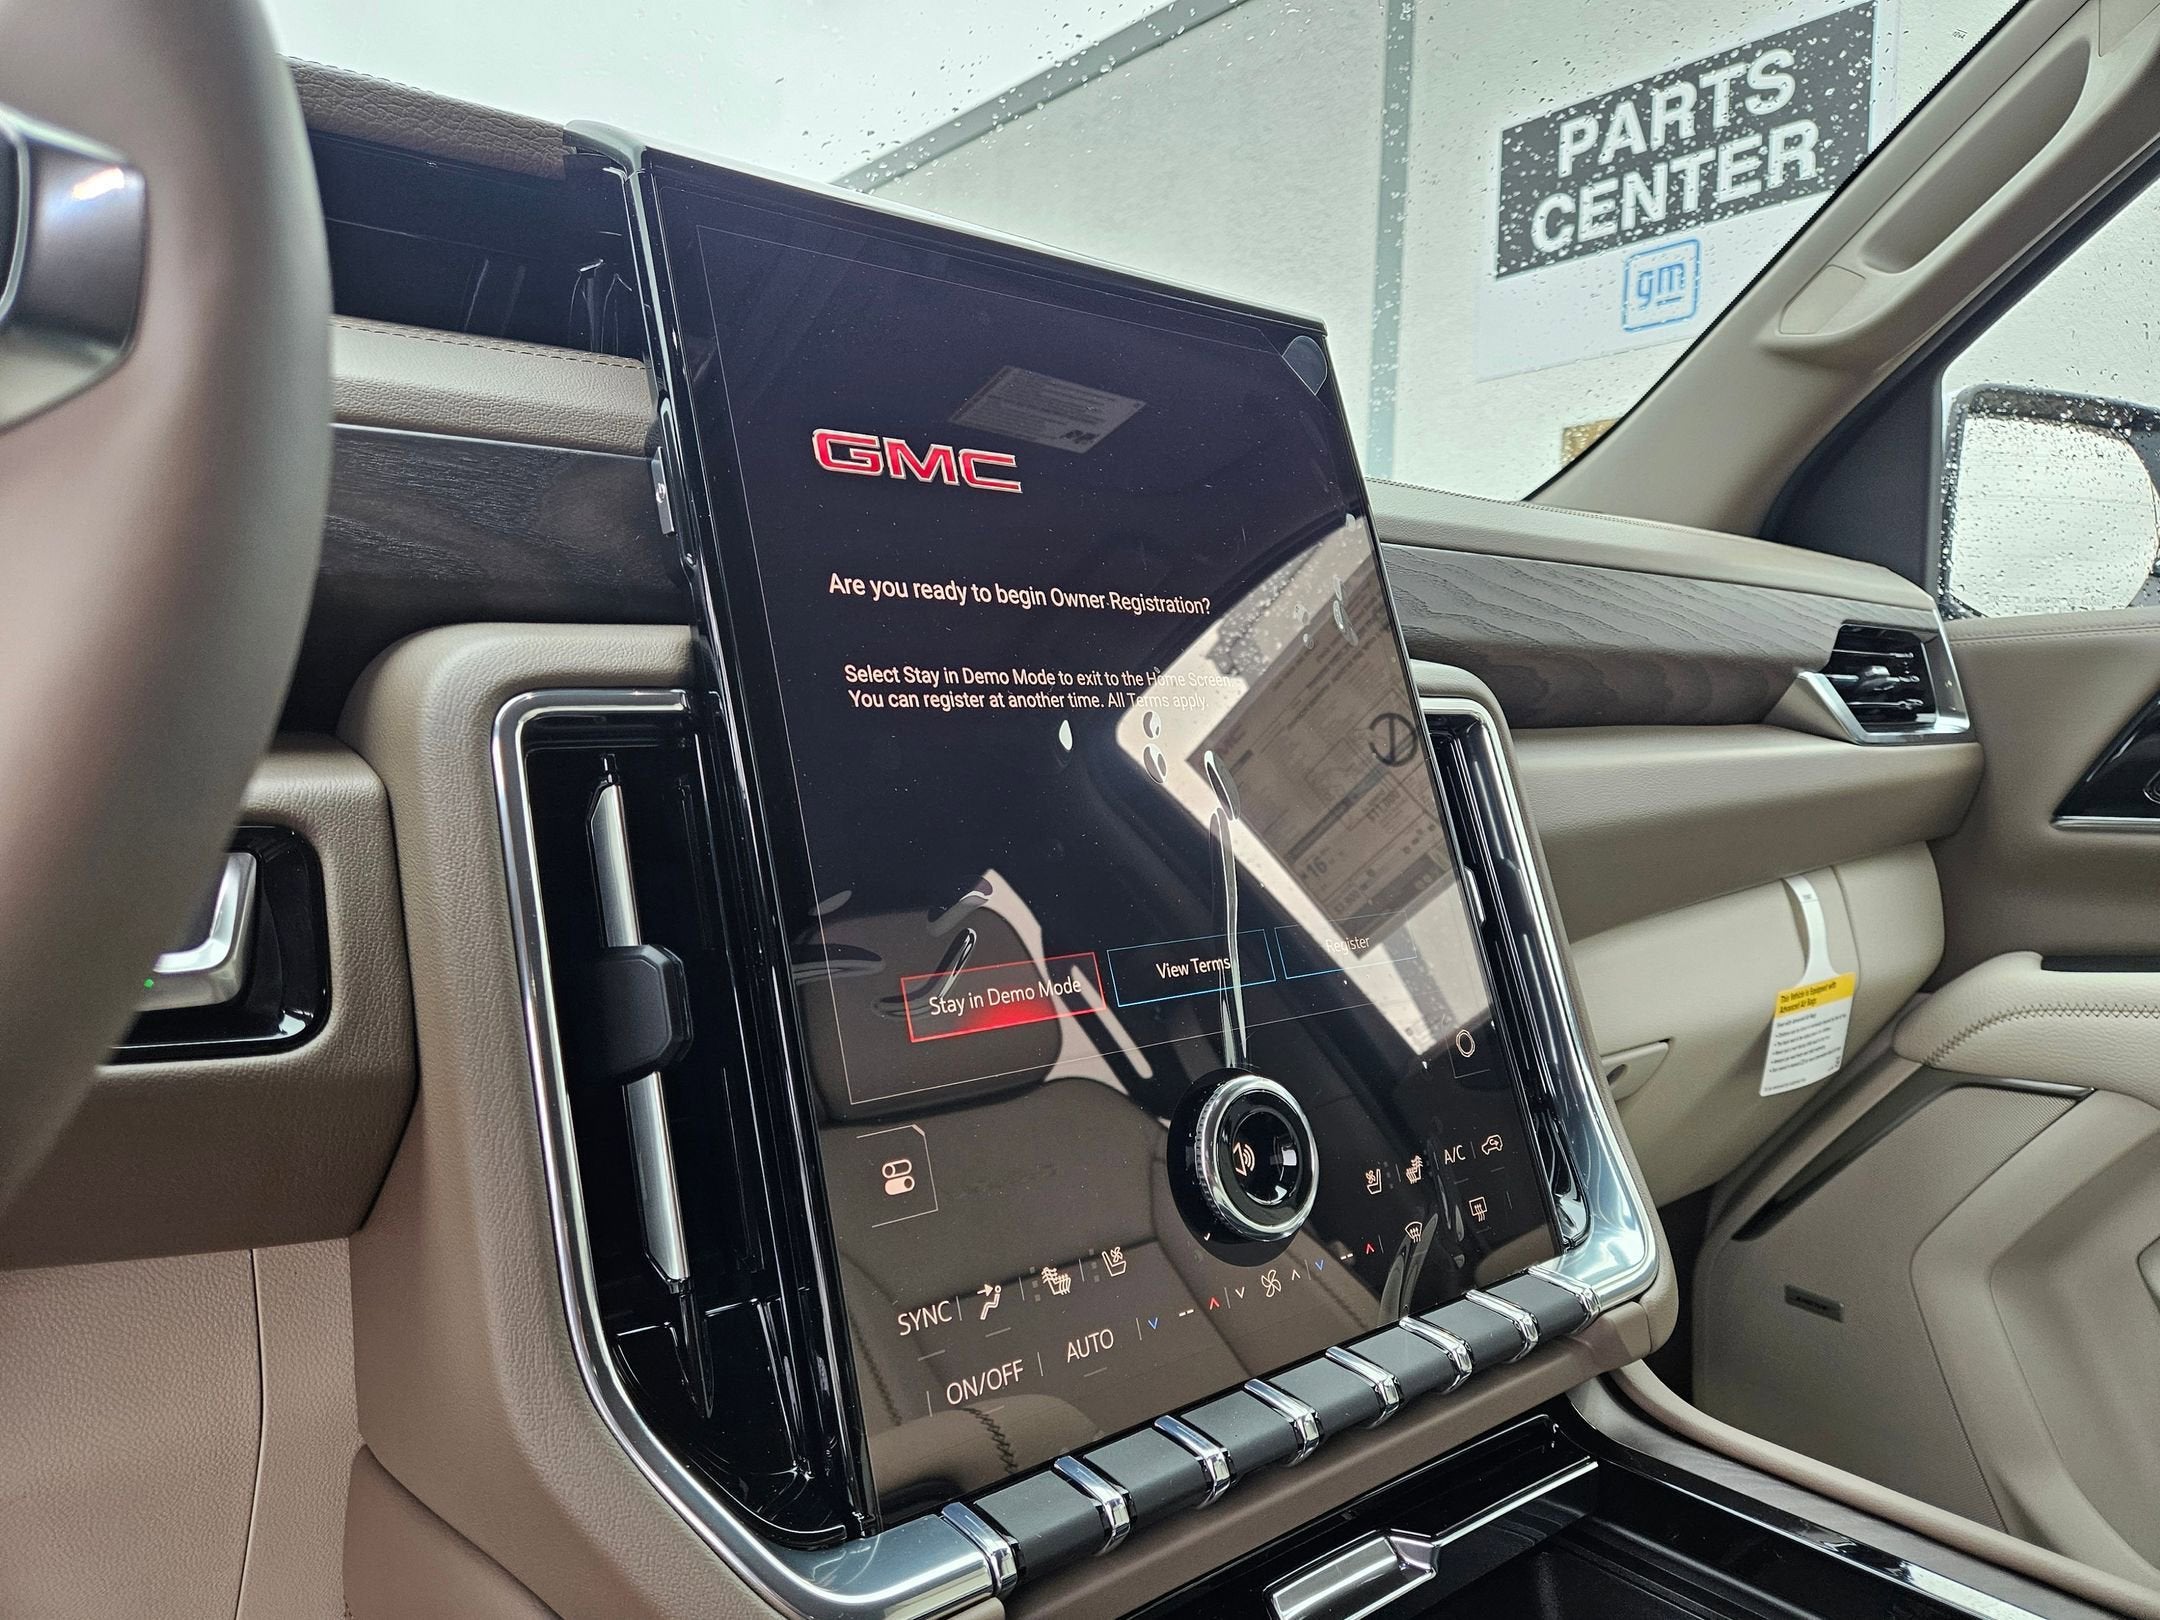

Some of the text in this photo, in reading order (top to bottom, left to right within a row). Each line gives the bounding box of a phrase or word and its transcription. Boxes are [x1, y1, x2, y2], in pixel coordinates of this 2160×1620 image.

[1557, 48, 1796, 178] PARTS
[1531, 119, 1819, 254] CENTER
[1637, 260, 1686, 307] gm
[812, 428, 1023, 494] GMC
[829, 572, 1211, 615] Are you ready to begin Owner Registration?
[844, 664, 1234, 688] Select Stay in Demo Mode to exit to the Home Screen.
[848, 690, 1209, 712] You can register at another time. All Terms apply.
[1324, 936, 1371, 956] Register
[1155, 956, 1231, 979] View Terms
[928, 975, 1083, 1016] Stay in Demo Mode
[1444, 1144, 1466, 1165] A/C
[897, 1300, 953, 1336] SYNC
[1066, 1328, 1115, 1363] AUTO
[946, 1359, 1025, 1406] ON/OFF
